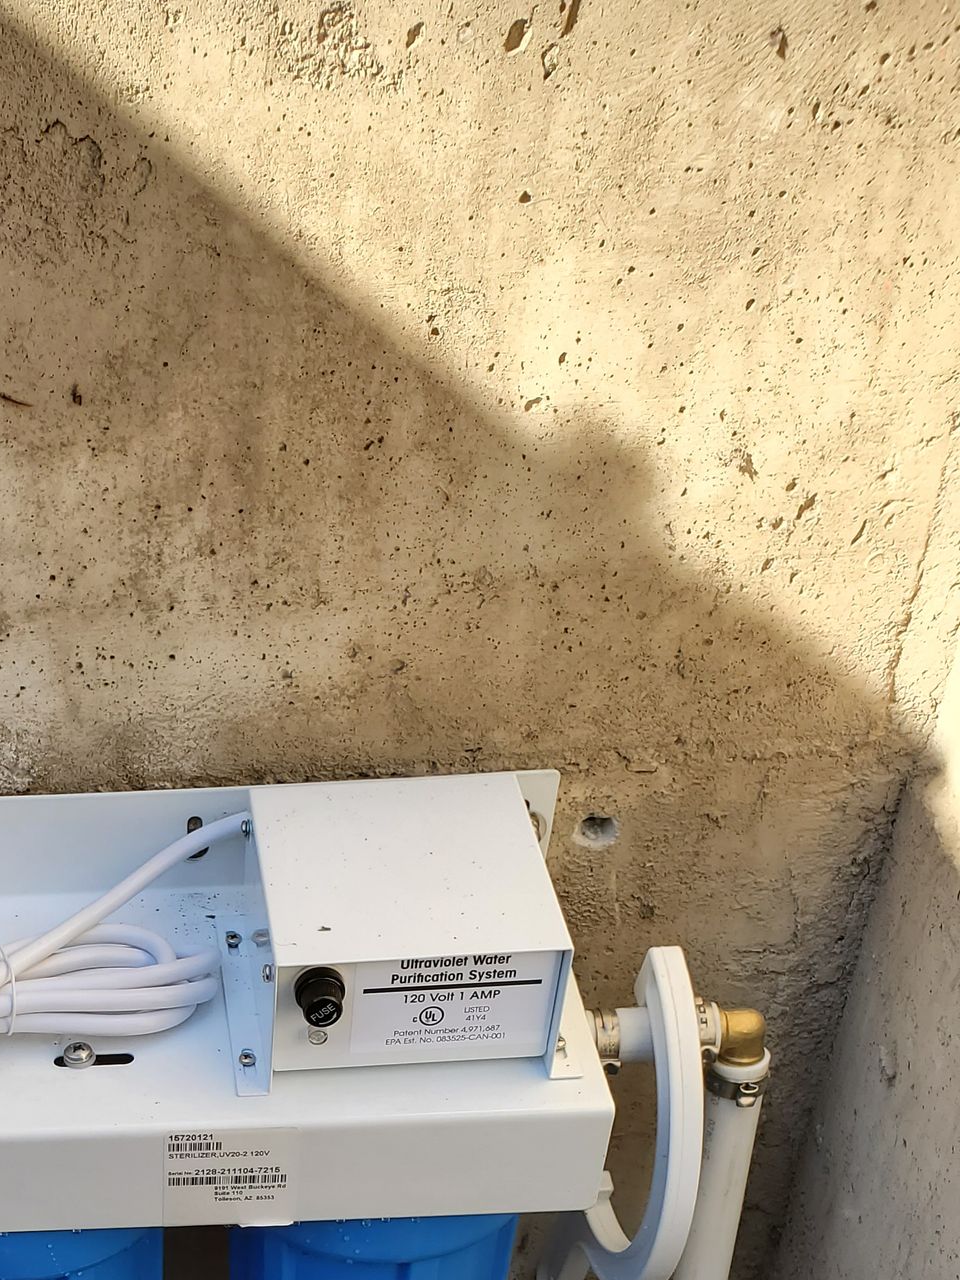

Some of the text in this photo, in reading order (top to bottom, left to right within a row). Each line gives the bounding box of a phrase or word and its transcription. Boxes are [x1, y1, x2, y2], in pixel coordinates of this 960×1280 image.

[400, 955, 512, 970] Ultraviolet Water
[391, 969, 517, 984] Purification System
[404, 989, 501, 1003] 120 Volt 1 AMP
[310, 1003, 336, 1021] FUSE
[464, 1005, 490, 1013] LISTED
[393, 1024, 500, 1037] Patent Number 4,971,687
